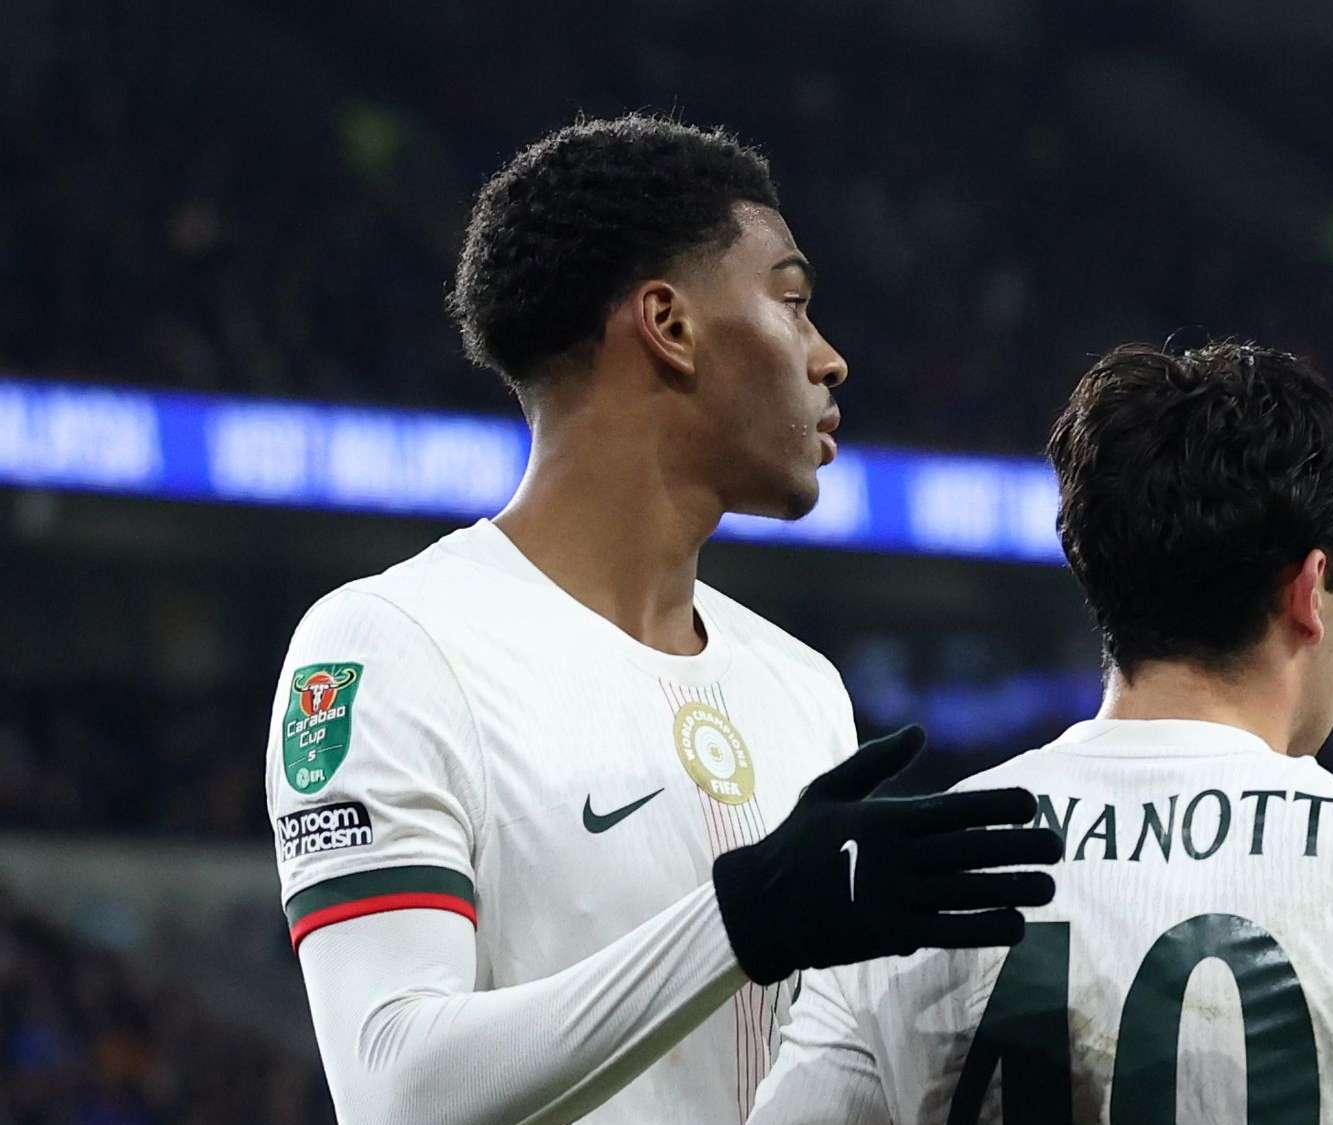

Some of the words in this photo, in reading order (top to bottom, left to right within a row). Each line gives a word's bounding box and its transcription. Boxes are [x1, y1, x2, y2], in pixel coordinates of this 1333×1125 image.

[287, 705, 346, 737] Carabao
[299, 728, 326, 747] Cup
[310, 769, 326, 782] EFL
[278, 817, 300, 841] No
[301, 806, 360, 834] room
[280, 839, 300, 861] for
[300, 825, 372, 853] racism
